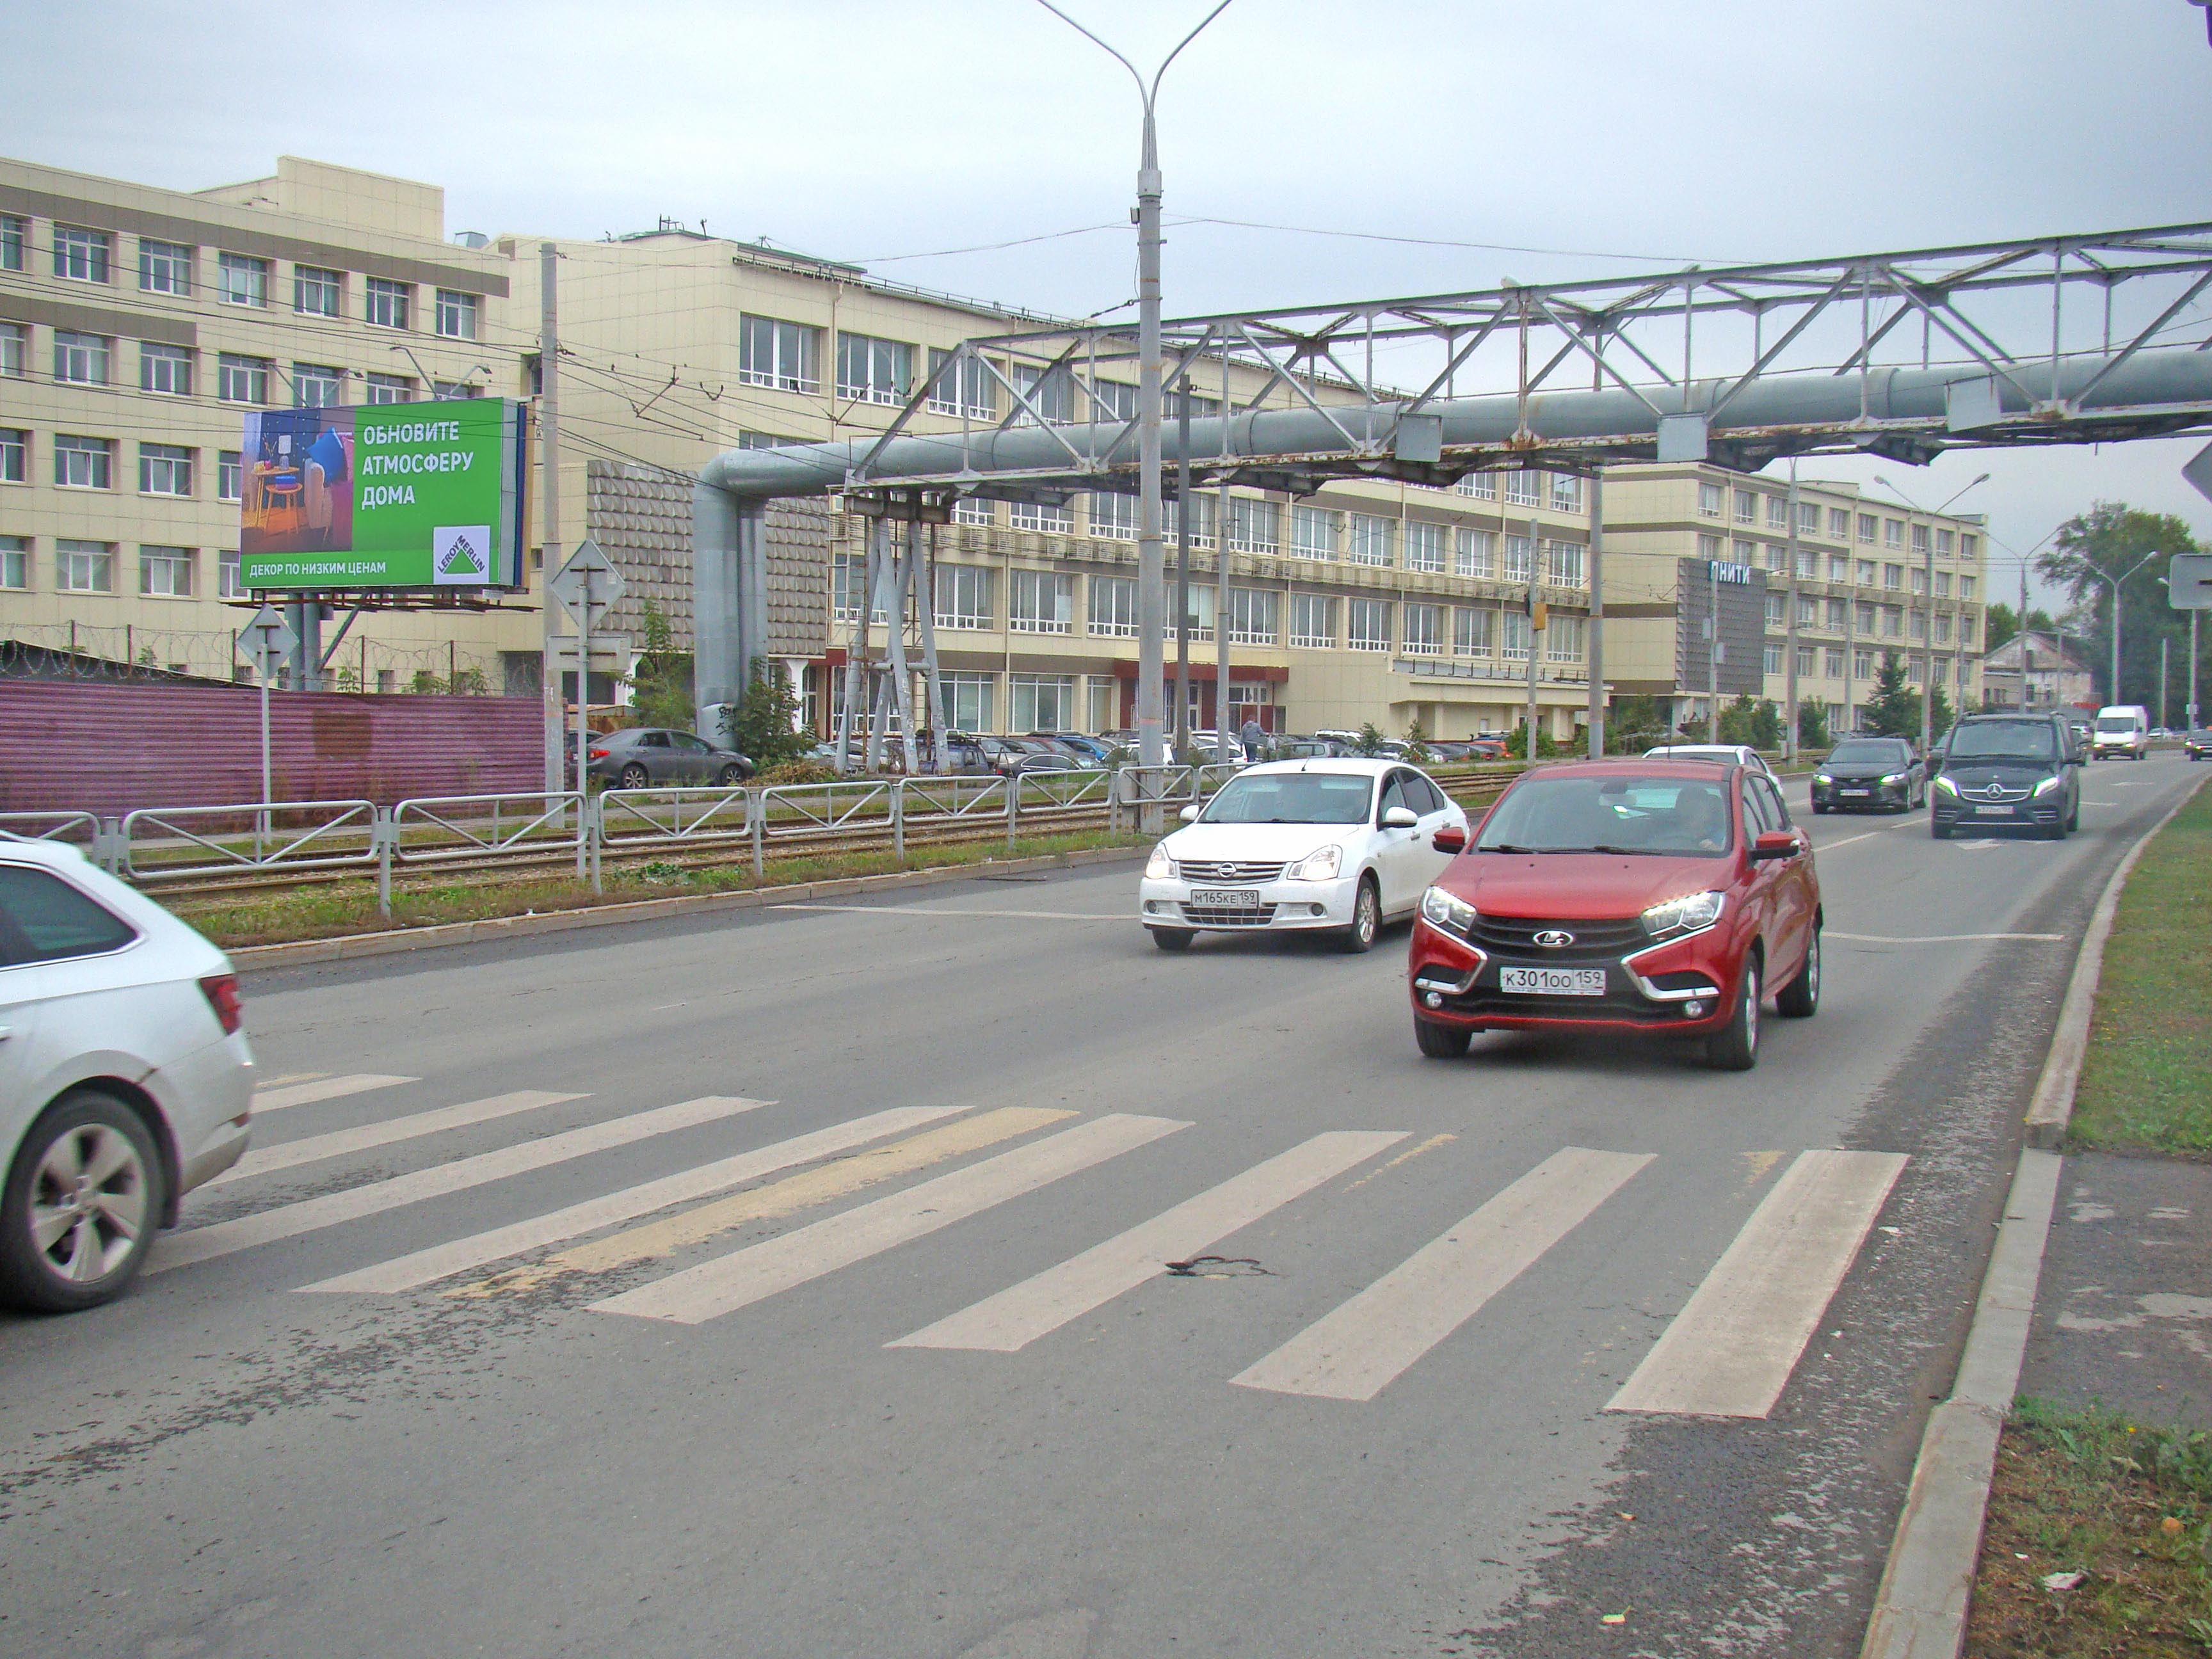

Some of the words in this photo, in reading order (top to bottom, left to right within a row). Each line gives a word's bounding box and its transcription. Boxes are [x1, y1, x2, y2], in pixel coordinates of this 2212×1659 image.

[363, 421, 460, 445] ОБНОВИТЕ
[362, 451, 474, 476] АТМОСФЕРУ
[361, 485, 415, 510] ДОМА
[437, 541, 460, 573] LEROY
[457, 534, 485, 572] MERLIN
[249, 563, 283, 578] ДЕКОР
[285, 563, 300, 574] ПО
[301, 562, 346, 574] НИЗКИМ
[348, 561, 386, 575] ЦЕНАМ
[1239, 892, 1254, 901] 159
[1575, 971, 1601, 984] 159
